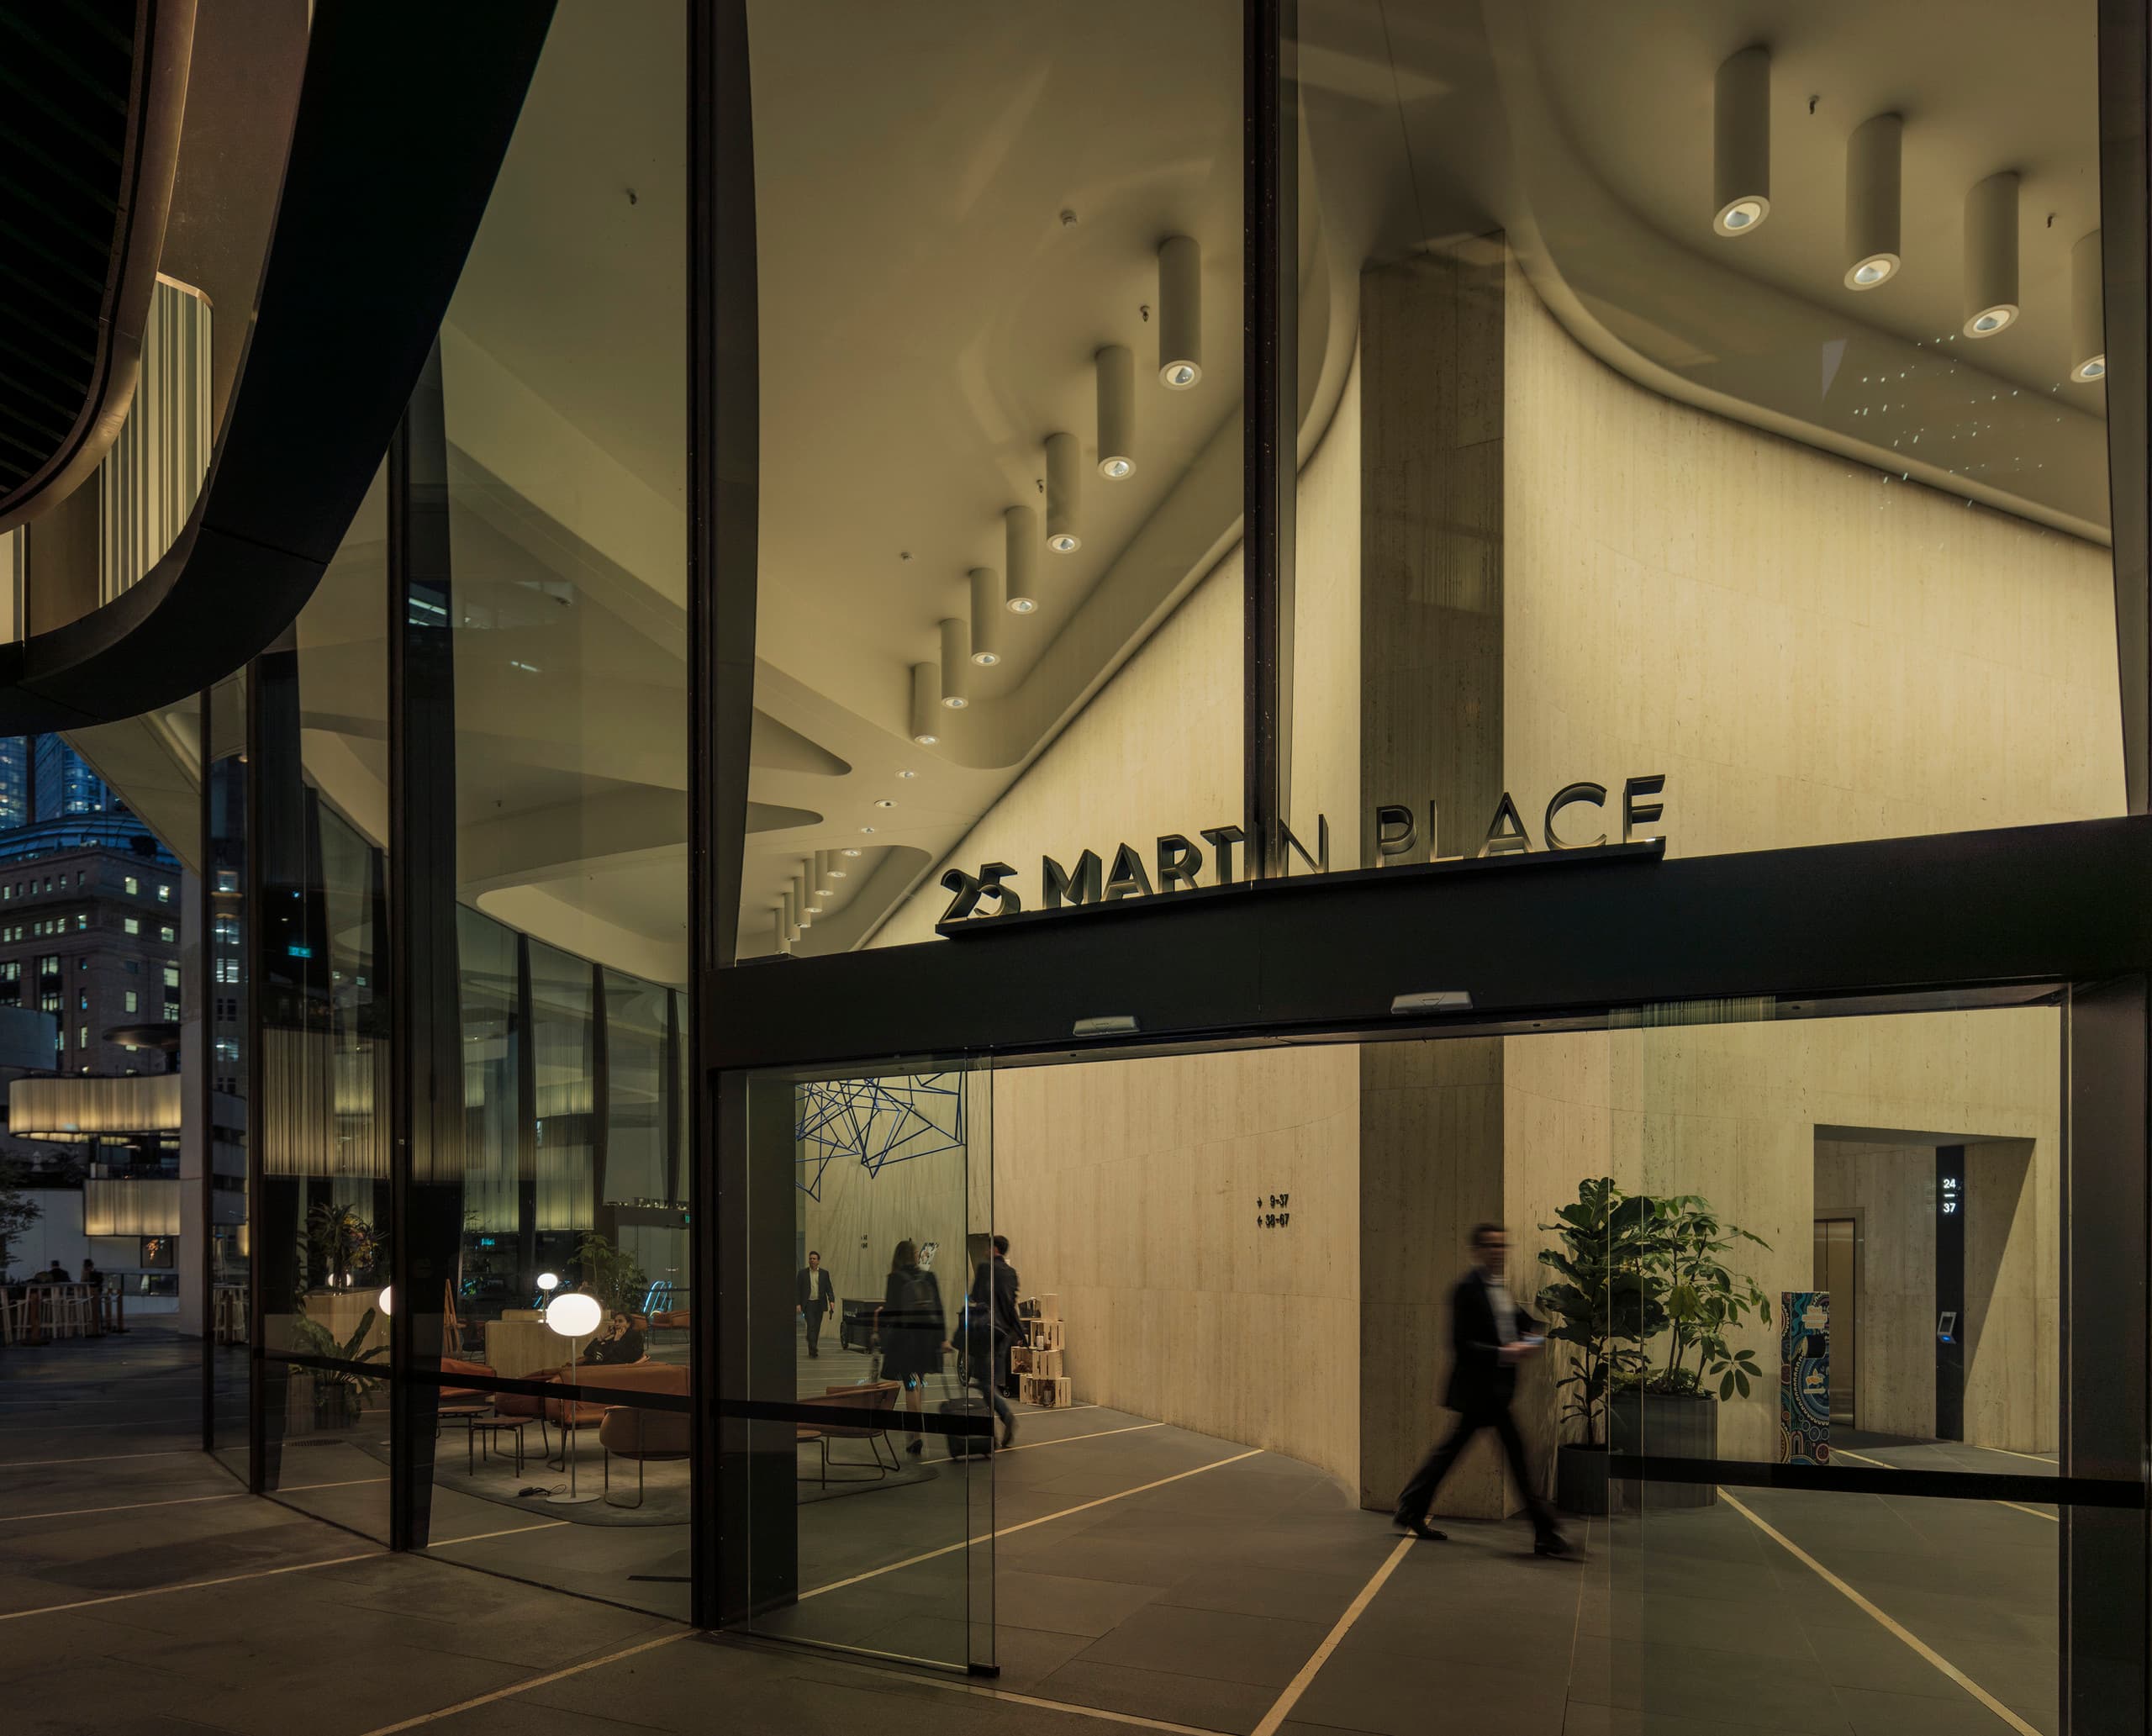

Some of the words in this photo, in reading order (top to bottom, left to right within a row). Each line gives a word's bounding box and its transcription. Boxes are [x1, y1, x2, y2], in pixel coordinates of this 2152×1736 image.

[938, 862, 1021, 924] 25
[1042, 813, 1328, 909] MARTIN
[1376, 773, 1665, 868] PLACE
[1943, 1178, 1956, 1189] 24
[1943, 1202, 1956, 1213] 37
